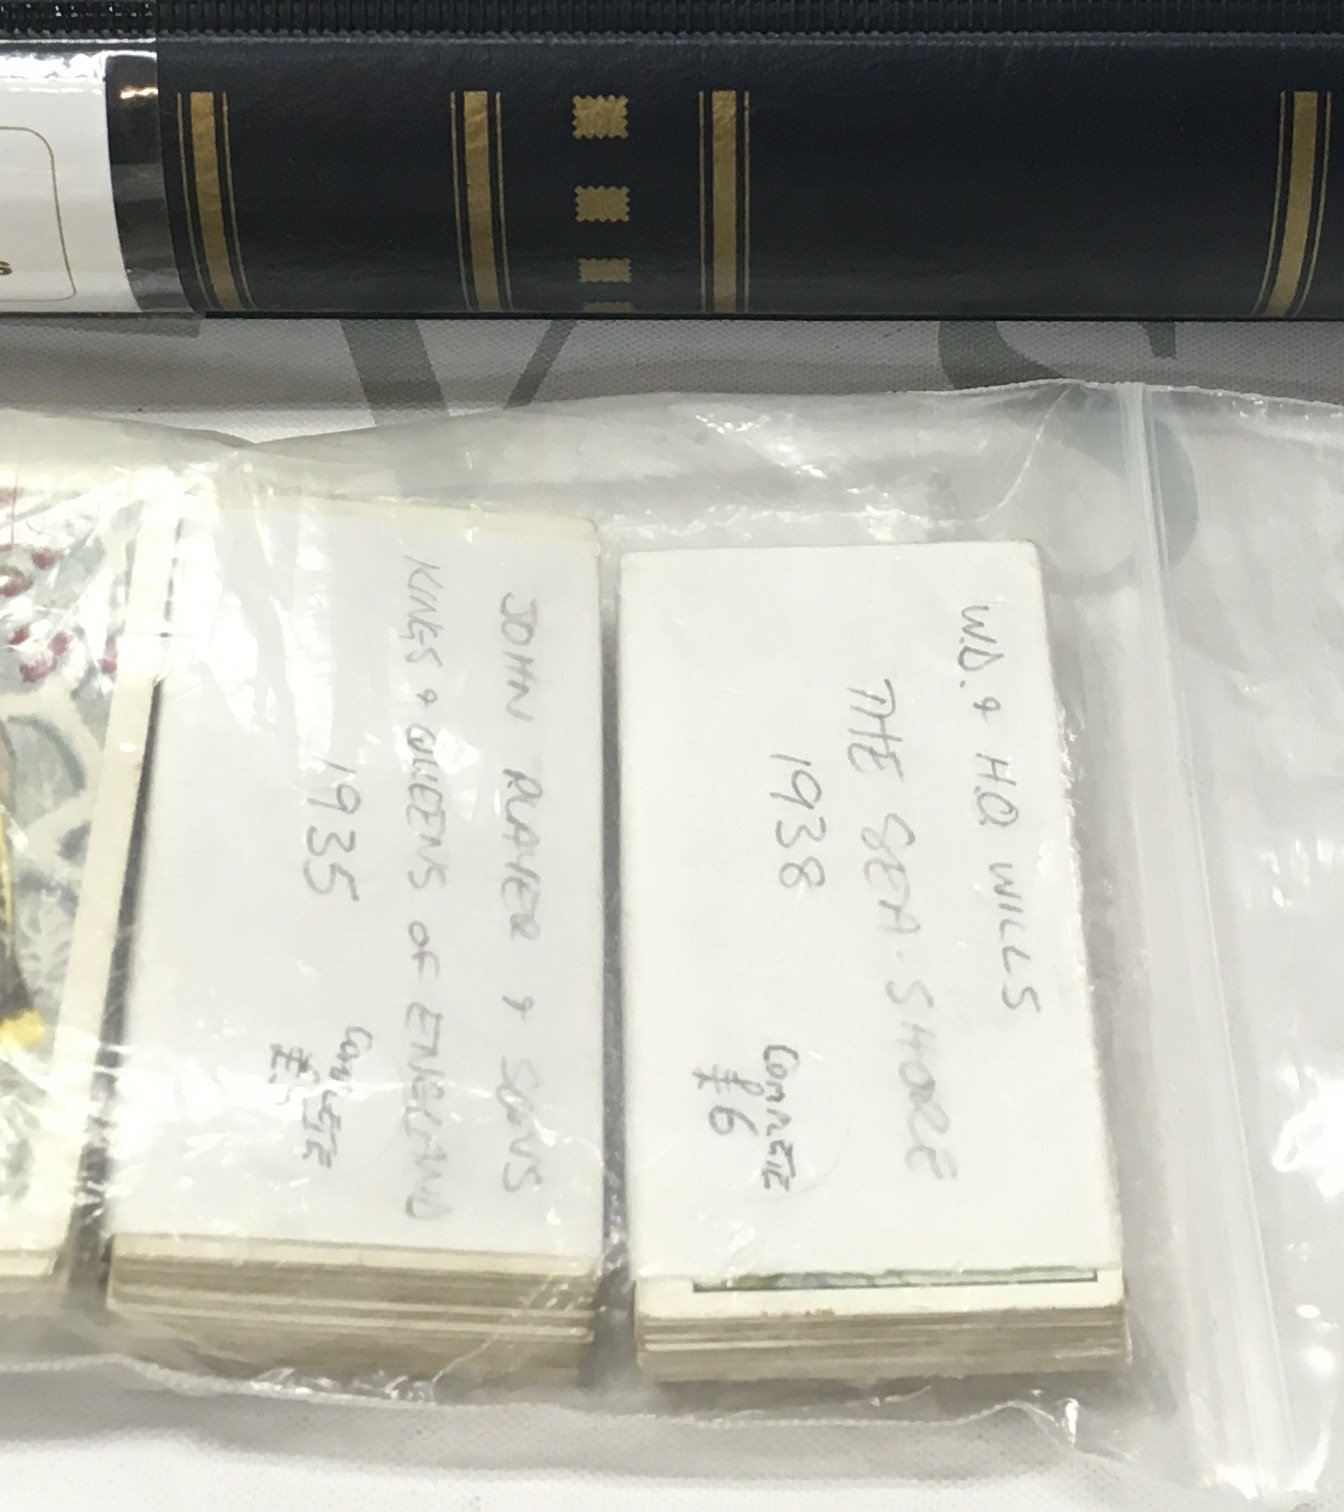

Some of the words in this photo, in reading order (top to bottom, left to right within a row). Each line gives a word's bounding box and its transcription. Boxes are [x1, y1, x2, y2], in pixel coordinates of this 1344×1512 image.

[402, 554, 444, 667] KINGS
[499, 592, 539, 723] JOHN
[848, 678, 903, 784] THE
[302, 755, 361, 902] 1935
[405, 725, 449, 891] QUEENS
[501, 767, 544, 943] PLAYER
[770, 754, 826, 890] 1938
[988, 860, 1041, 1014] WILLS
[403, 1003, 452, 1221] ENGLAND
[692, 1064, 764, 1137] £6
